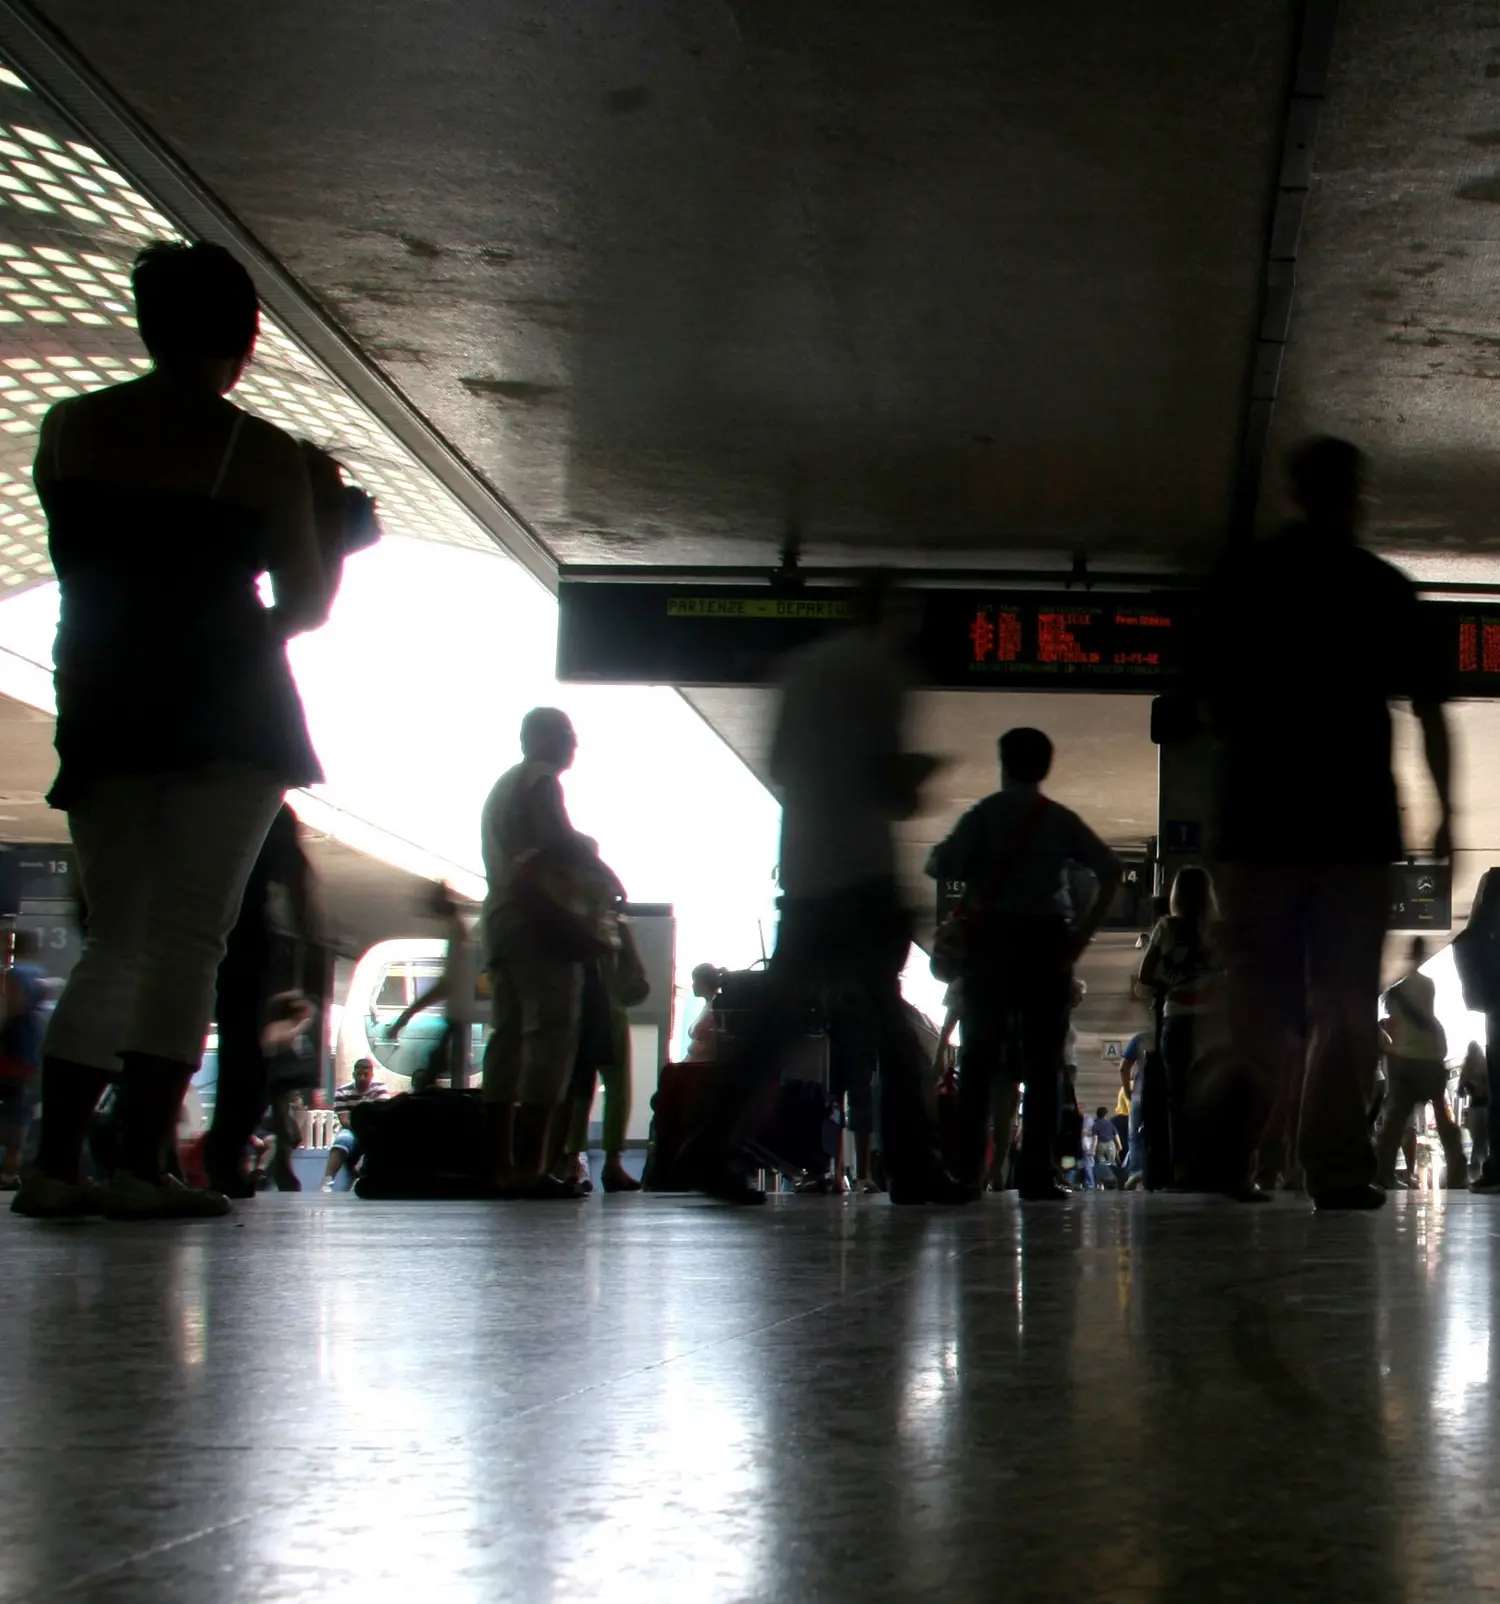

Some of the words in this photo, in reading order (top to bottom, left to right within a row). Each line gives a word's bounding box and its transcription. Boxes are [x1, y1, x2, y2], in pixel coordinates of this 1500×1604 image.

[668, 599, 746, 614] PARTENZE
[776, 601, 850, 616] DEPARTU
[48, 860, 68, 874] 13
[34, 926, 68, 950] 13
[1106, 1044, 1118, 1056] A
